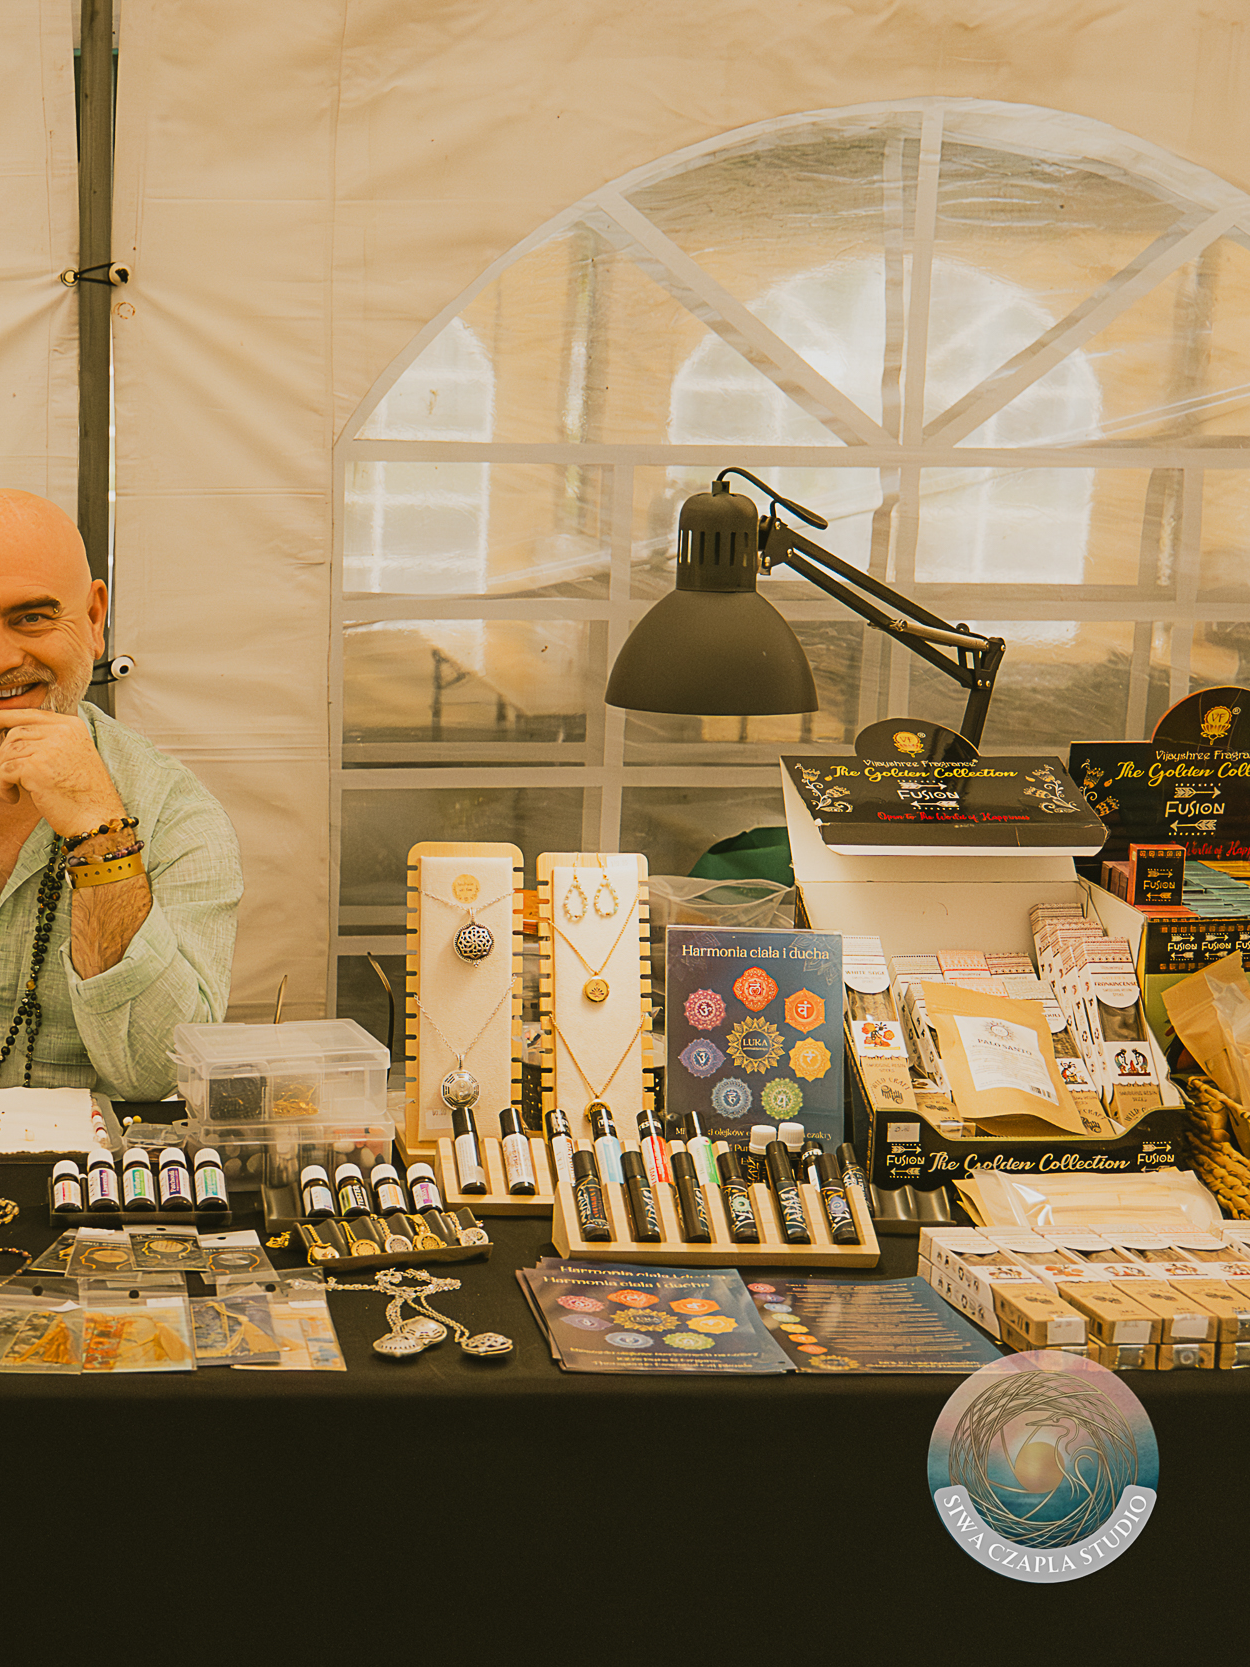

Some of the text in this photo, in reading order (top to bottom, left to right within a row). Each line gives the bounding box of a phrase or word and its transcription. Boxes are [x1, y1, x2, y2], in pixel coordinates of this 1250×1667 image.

[1156, 750, 1211, 762] Vijayshree
[832, 765, 1018, 782] The Golden Collection
[1115, 761, 1145, 780] The
[1147, 762, 1214, 787] Golden
[897, 790, 960, 800] FUSION
[1165, 800, 1225, 818] FUSION
[1143, 880, 1176, 890] FUSION
[682, 944, 747, 958] Harmonia
[750, 946, 780, 959] ciała
[788, 947, 829, 960] ducha
[1167, 942, 1197, 952] FUSION
[1201, 941, 1232, 951] FUSION
[743, 1038, 768, 1047] LUKA
[886, 1152, 1175, 1179] FUSION The Golden Collection FUSION
[543, 1276, 618, 1287] Harmonia
